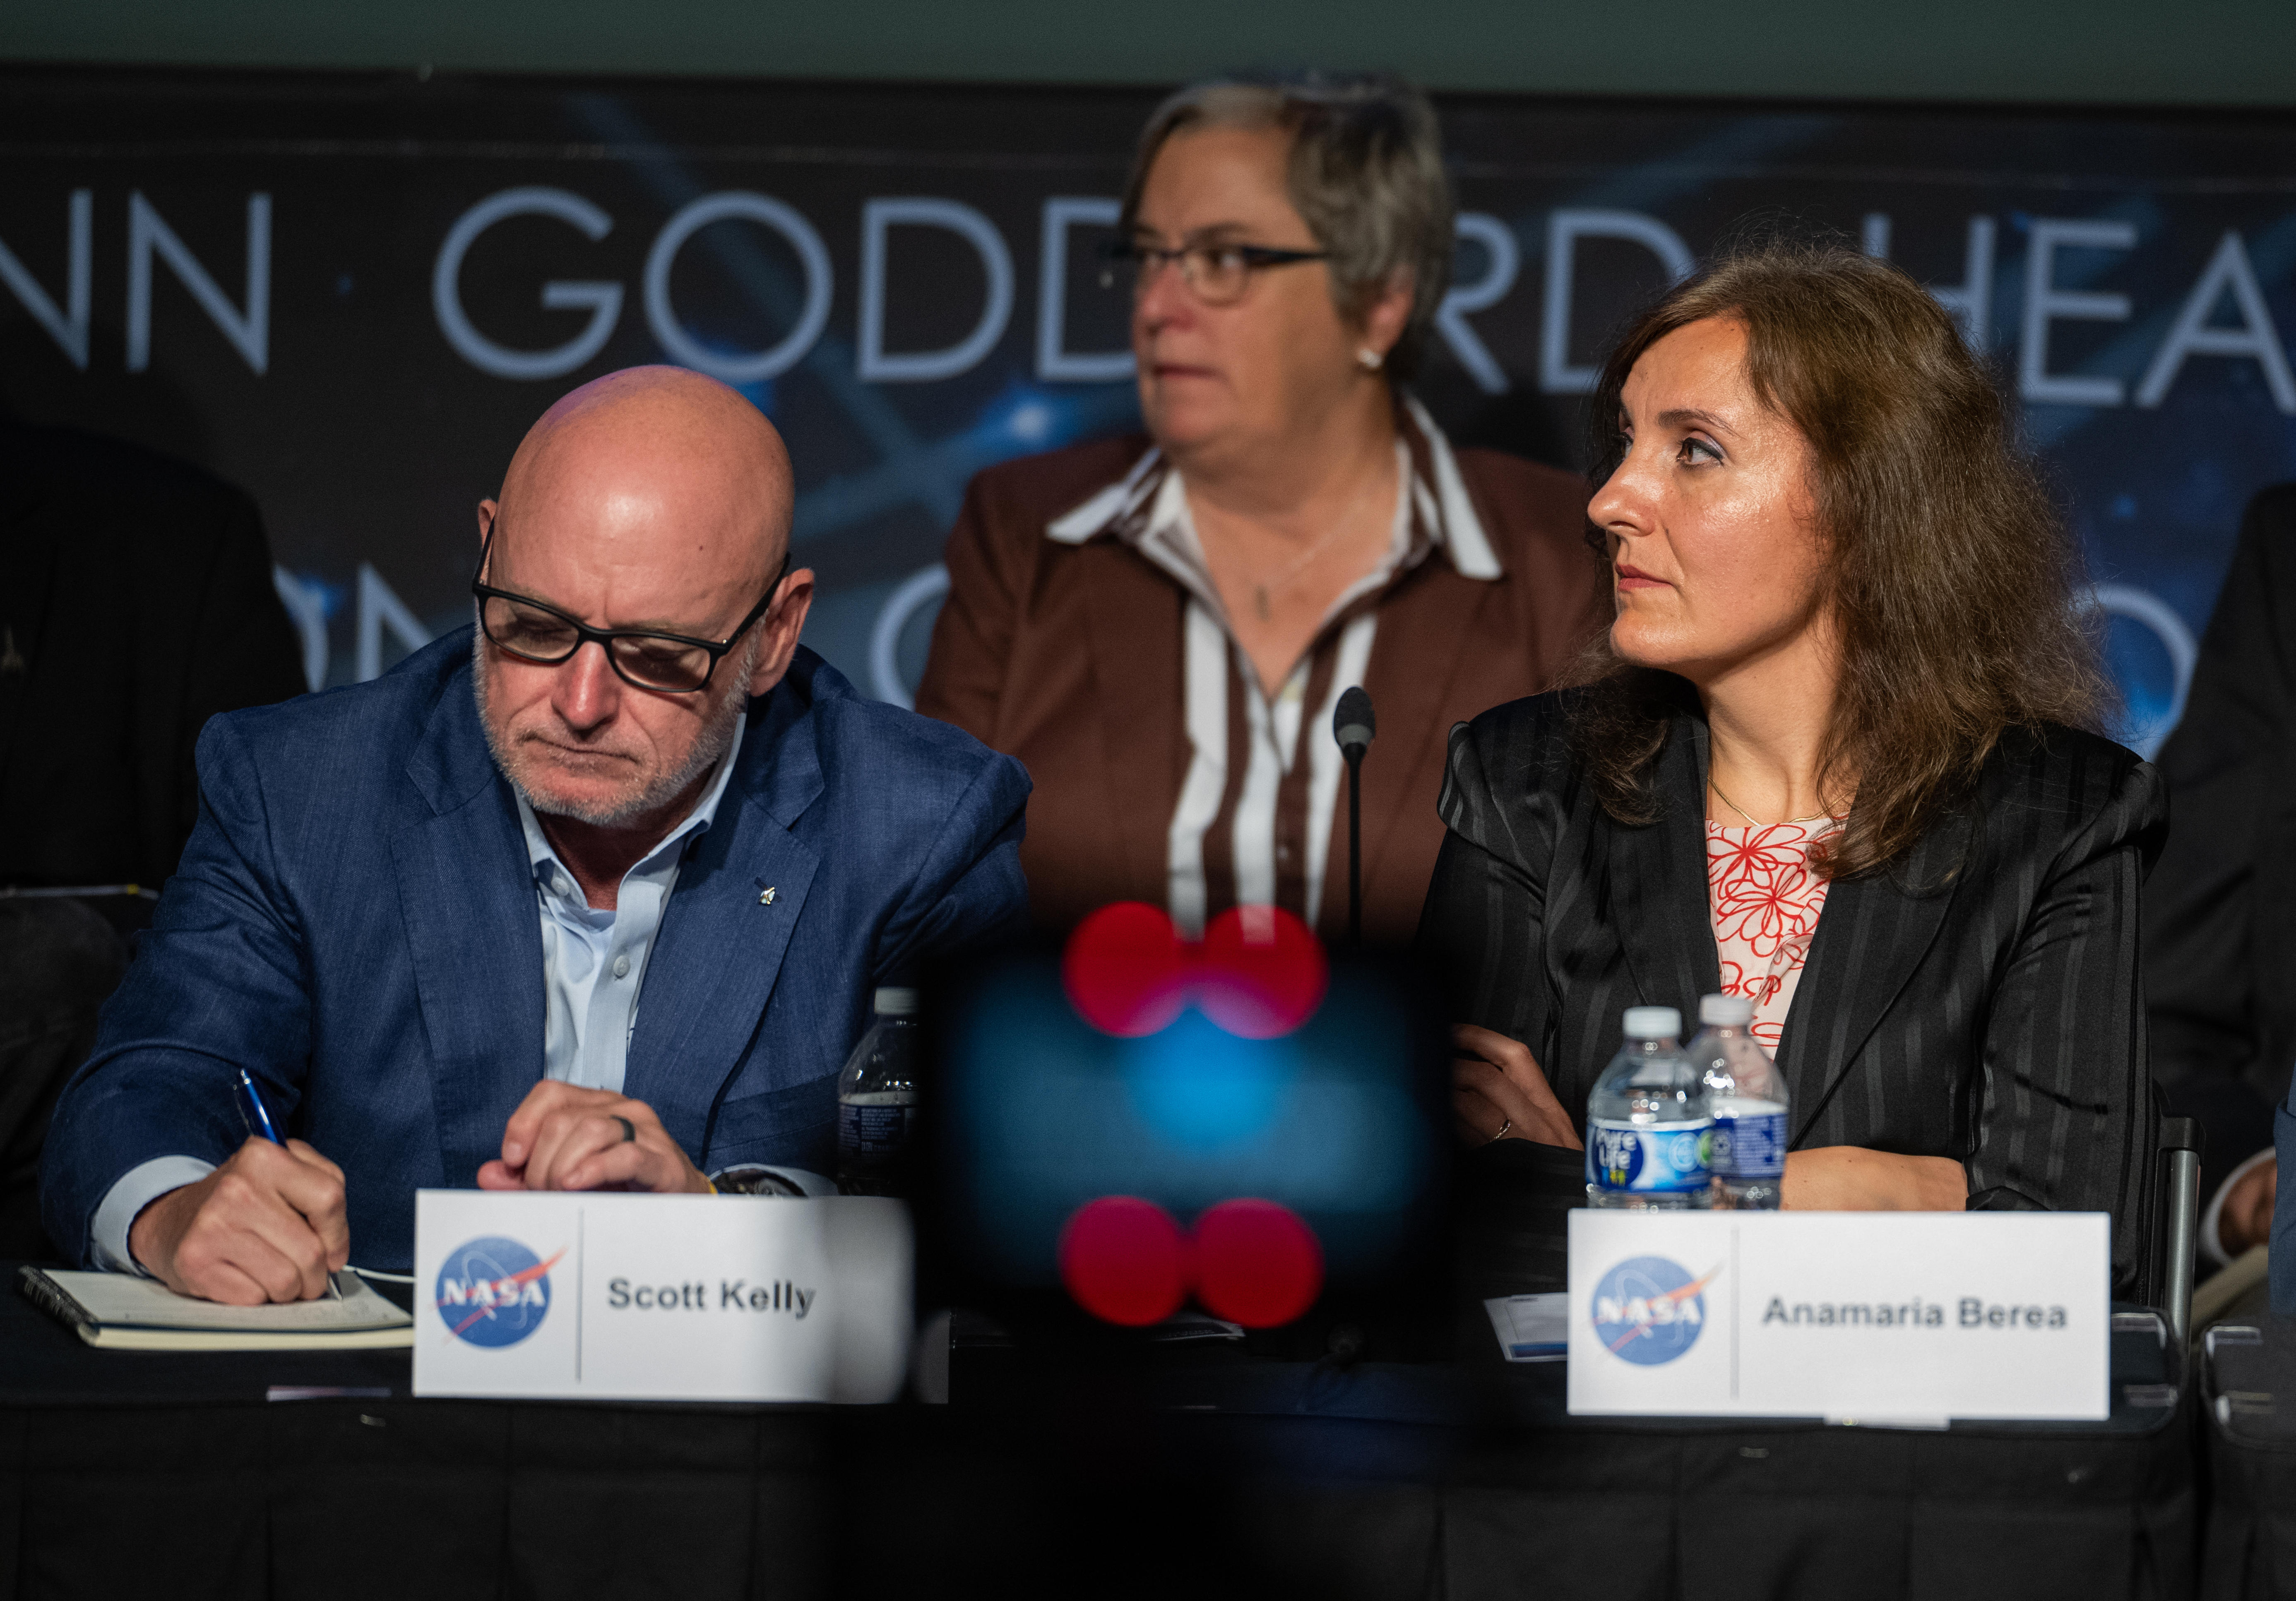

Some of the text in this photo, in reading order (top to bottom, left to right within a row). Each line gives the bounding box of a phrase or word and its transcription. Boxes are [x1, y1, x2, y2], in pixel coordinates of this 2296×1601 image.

[433, 186, 1696, 394] GODDRD
[444, 1278, 545, 1306] NASA
[608, 1277, 816, 1321] Scott Kelly
[1598, 1296, 1702, 1324] NASA
[1762, 1295, 2069, 1329] Anamaria Berea
